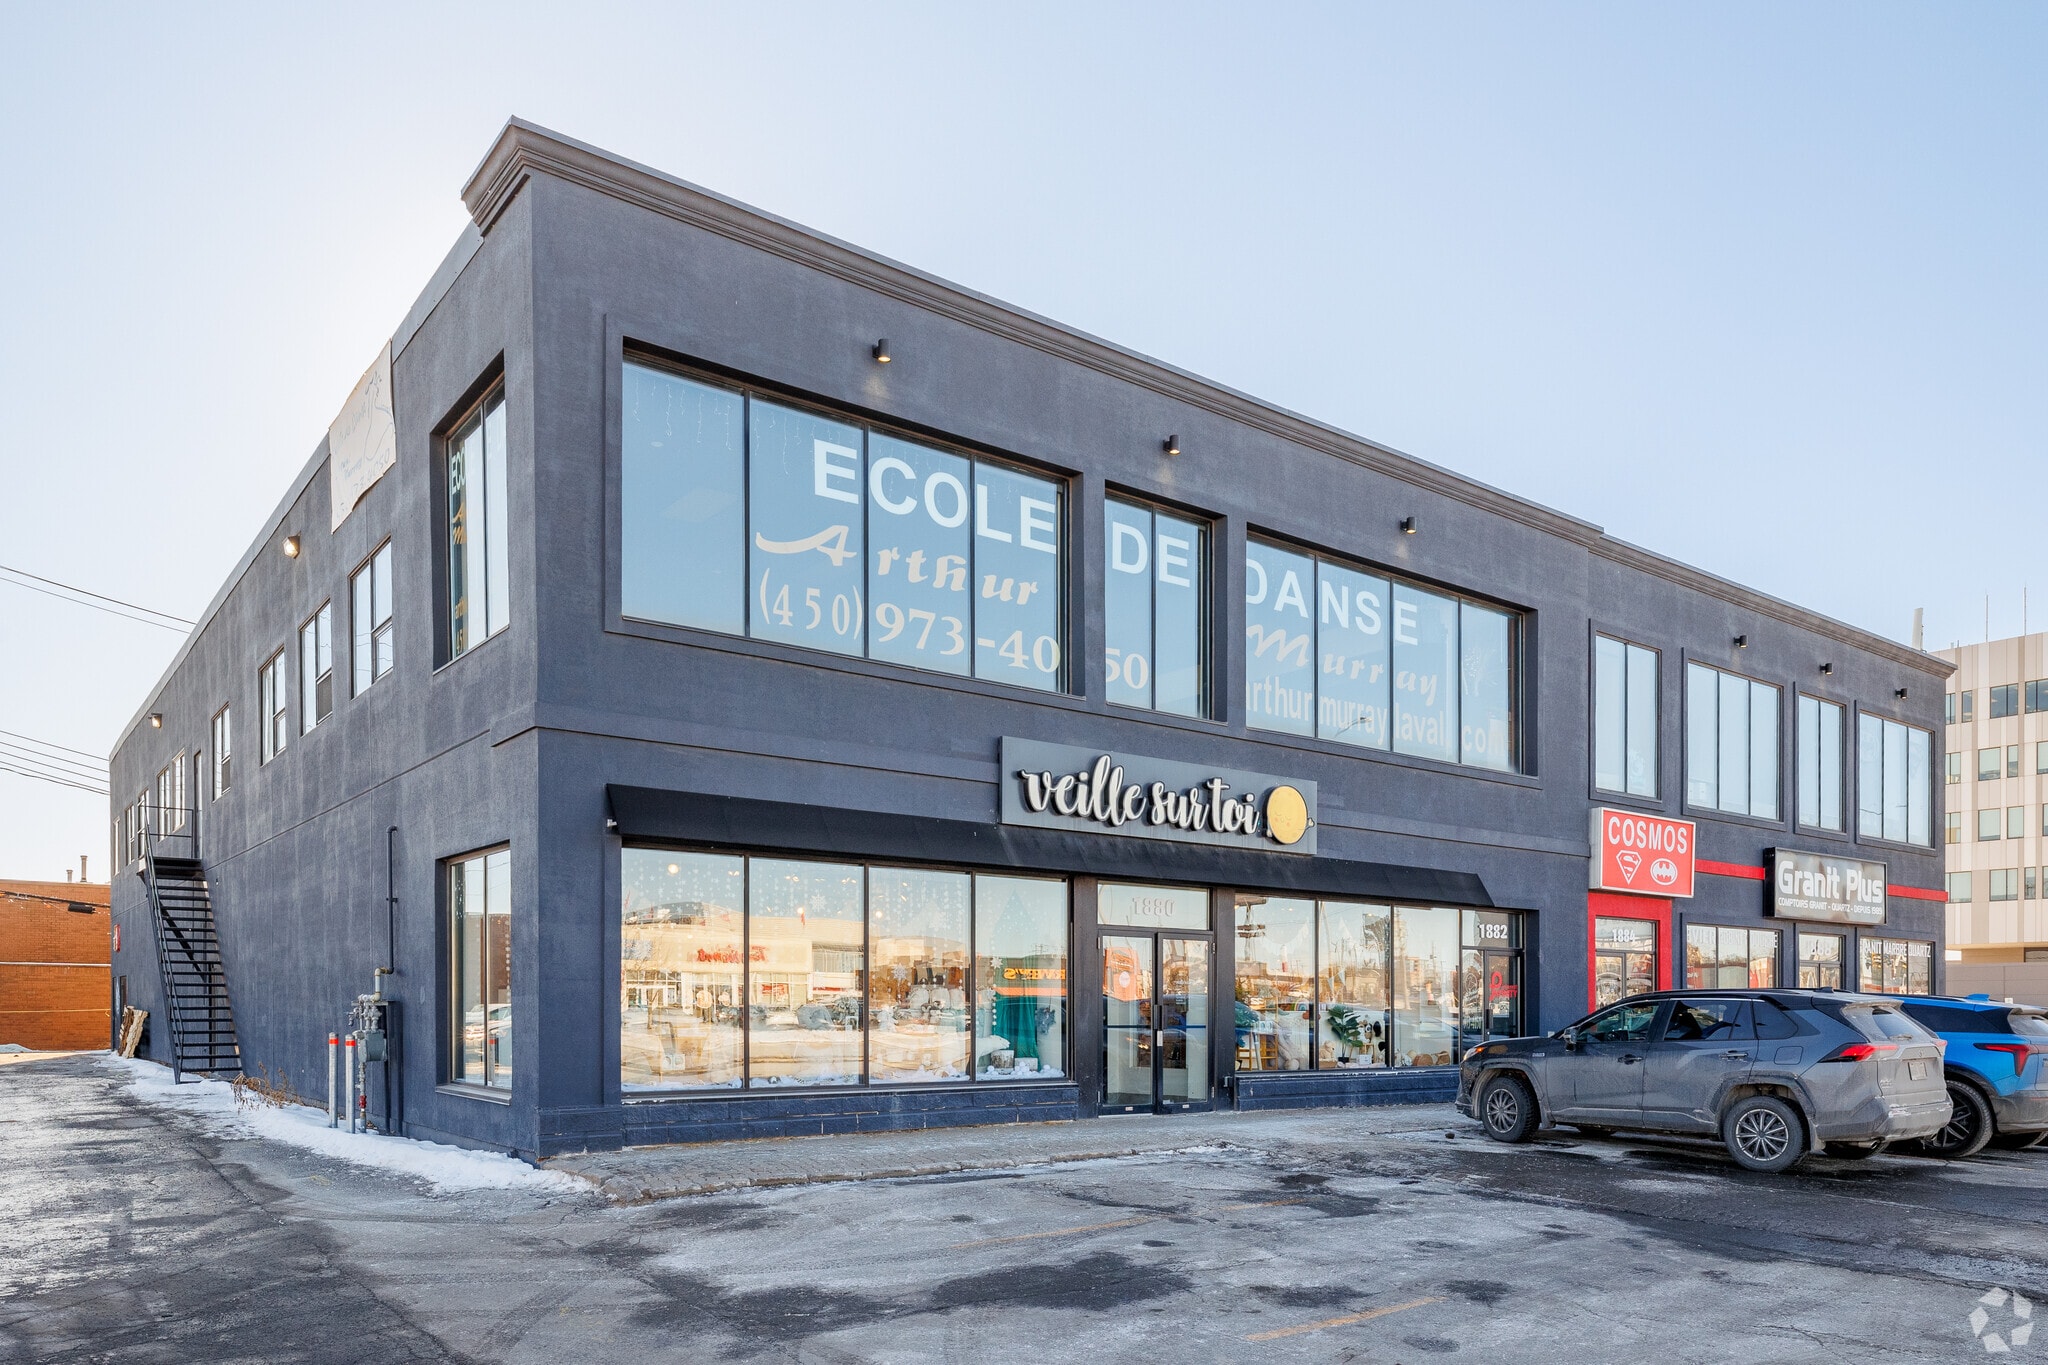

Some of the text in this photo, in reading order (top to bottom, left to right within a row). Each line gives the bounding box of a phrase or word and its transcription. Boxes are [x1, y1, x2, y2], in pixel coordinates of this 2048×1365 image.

[814, 439, 1419, 646] ECOLE DE DANSE
[755, 525, 1438, 707] Arthur Murray
[1017, 754, 1260, 834] veille sur toi
[1608, 816, 1688, 855] COSMOS
[1778, 860, 1883, 904] Granit Plus
[1132, 897, 1175, 917] 1880
[1778, 897, 1809, 909] COMPTOIRS
[1809, 901, 1828, 910] GRANIT
[1831, 903, 1851, 913] QUARTZ
[1854, 905, 1871, 914] DEPUIS
[1479, 924, 1508, 939] 1882
[1612, 929, 1636, 943] 1884
[1884, 941, 1907, 956] MARBRE
[1908, 944, 1932, 958] QUARTZ
